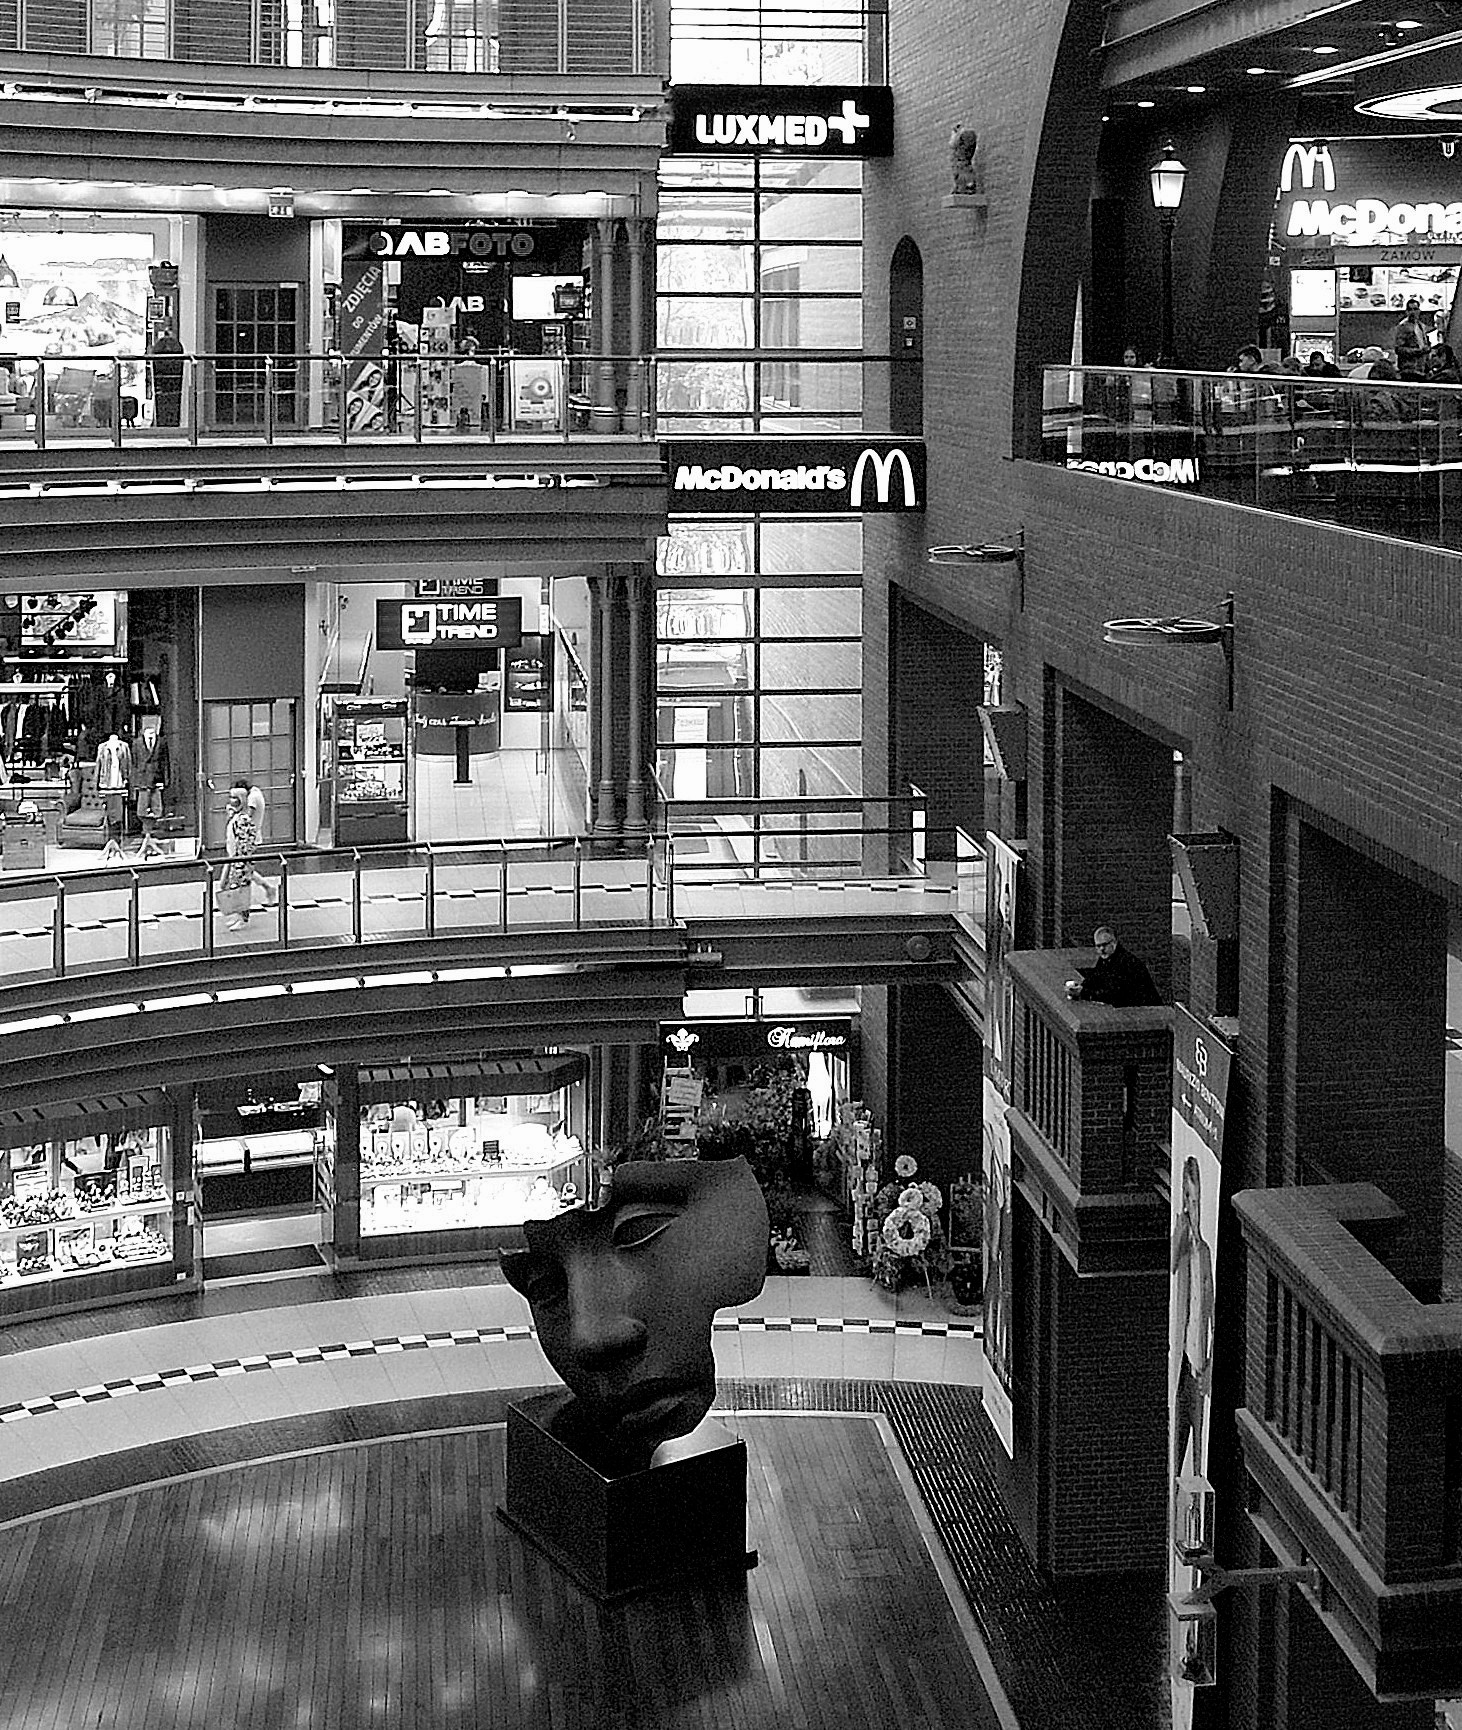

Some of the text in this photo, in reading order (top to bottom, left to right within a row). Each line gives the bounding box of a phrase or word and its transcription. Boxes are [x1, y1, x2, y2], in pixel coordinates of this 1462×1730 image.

[342, 266, 381, 313] ZDJĘCIA
[674, 465, 847, 490] McDonald's
[436, 603, 497, 621] TIME
[436, 624, 498, 639] TREND
